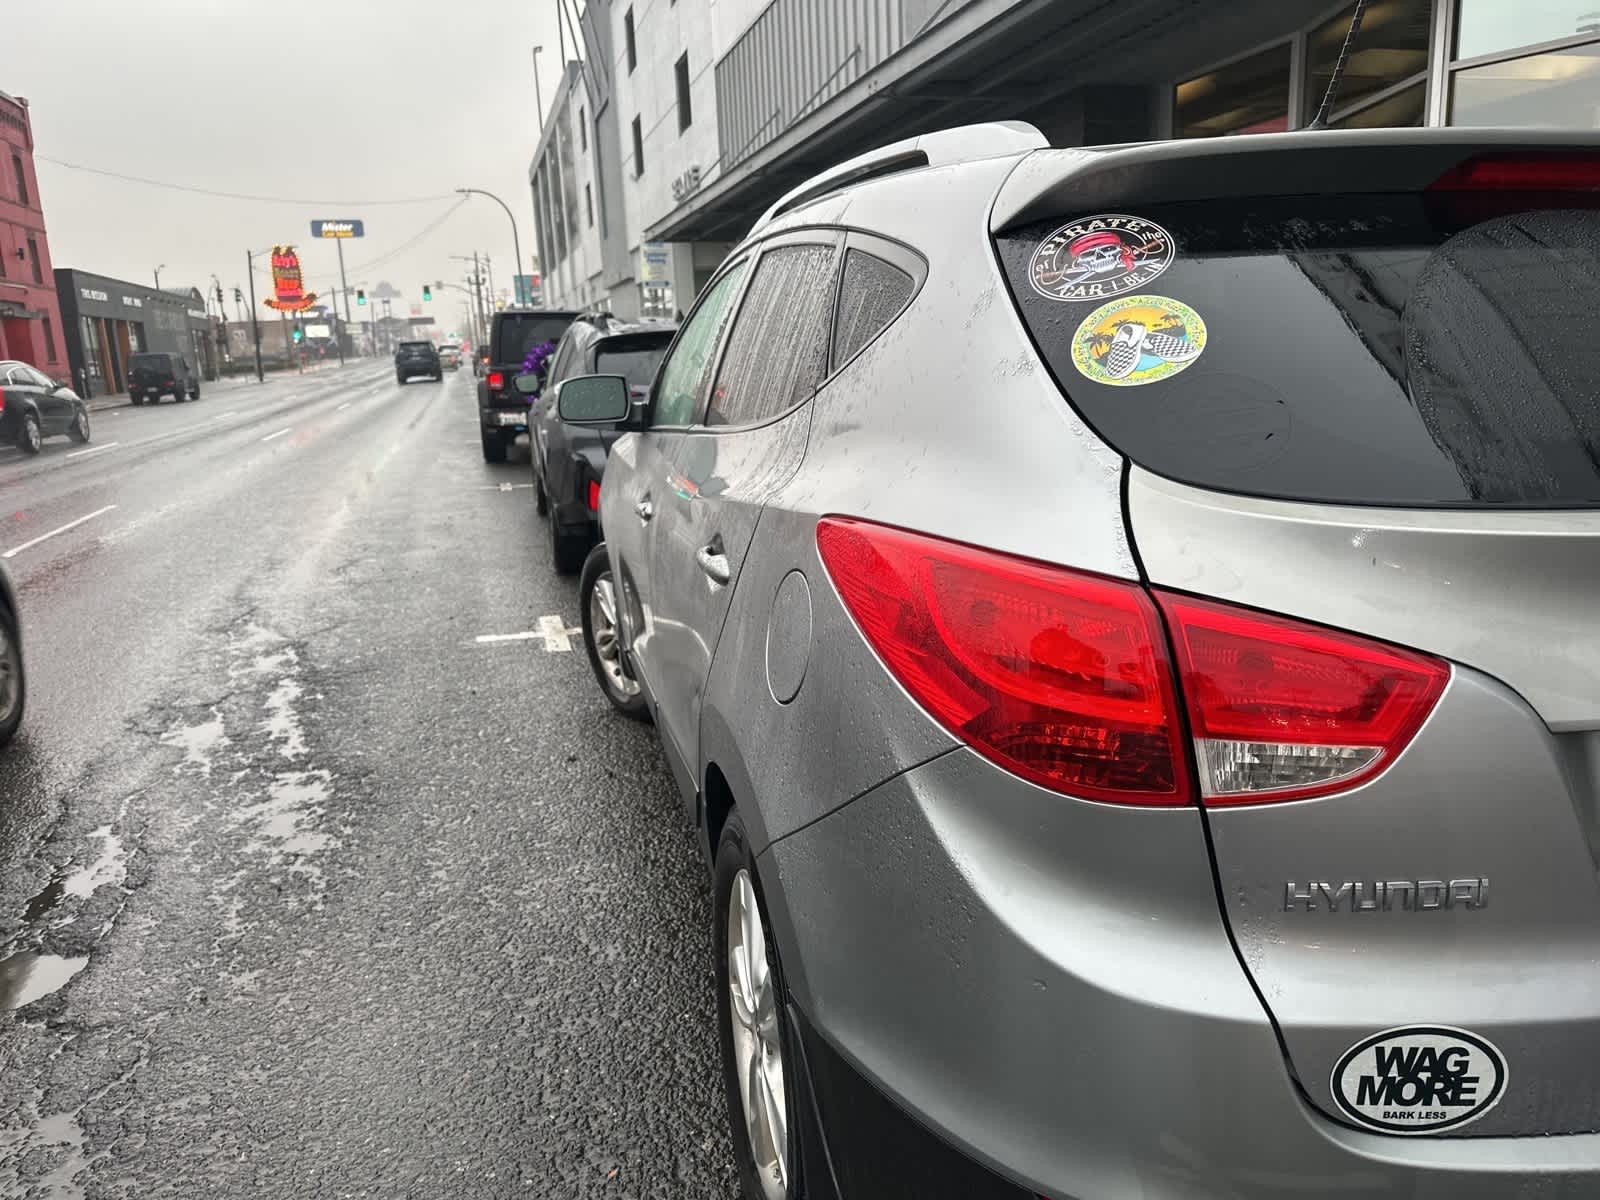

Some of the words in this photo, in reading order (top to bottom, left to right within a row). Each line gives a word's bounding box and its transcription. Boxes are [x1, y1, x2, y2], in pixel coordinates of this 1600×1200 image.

[1040, 218, 1147, 256] PIRATE
[1285, 878, 1489, 912] HYUNDAI
[1375, 1046, 1470, 1077] WAG
[1356, 1075, 1480, 1107] MORE
[1383, 1111, 1415, 1119] BARK
[1418, 1111, 1447, 1119] LESS
